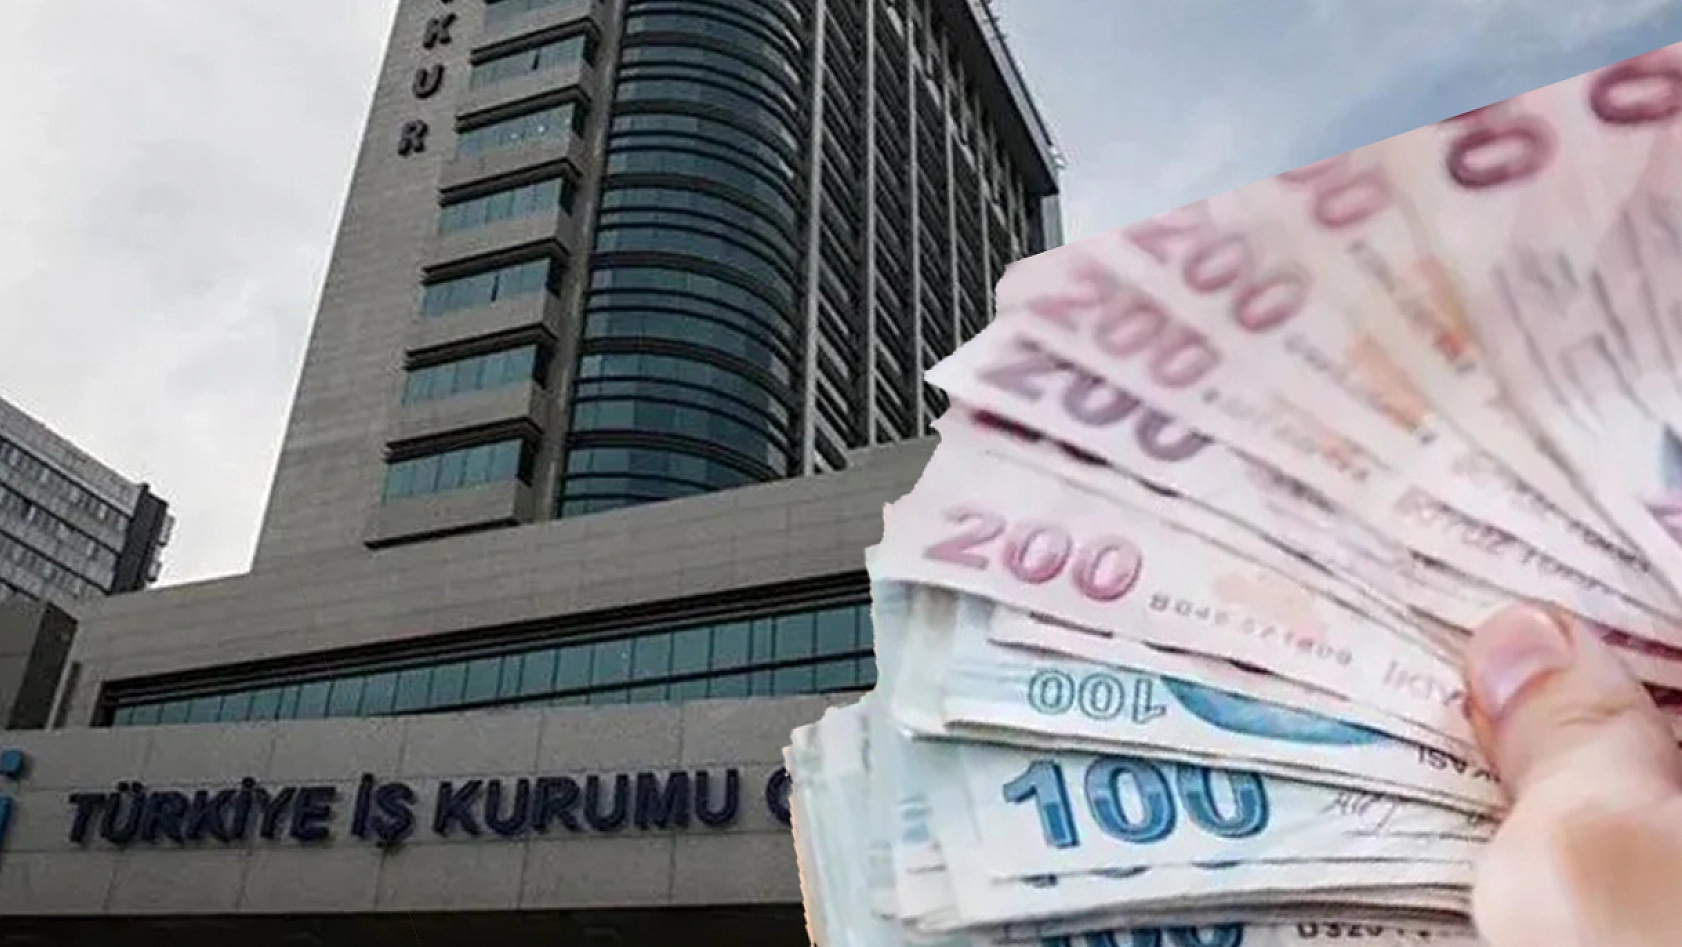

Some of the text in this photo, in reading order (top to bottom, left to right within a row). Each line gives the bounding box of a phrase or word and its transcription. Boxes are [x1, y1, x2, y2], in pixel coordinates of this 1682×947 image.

[398, 0, 456, 156] KUR
[1026, 255, 1223, 390] 200
[922, 505, 1143, 602] 200
[1027, 667, 1167, 725] 100
[69, 776, 336, 844] TÜRKİYE
[350, 772, 416, 850] İŞ
[432, 768, 740, 836] KURUMU
[1002, 755, 1271, 850] 100
